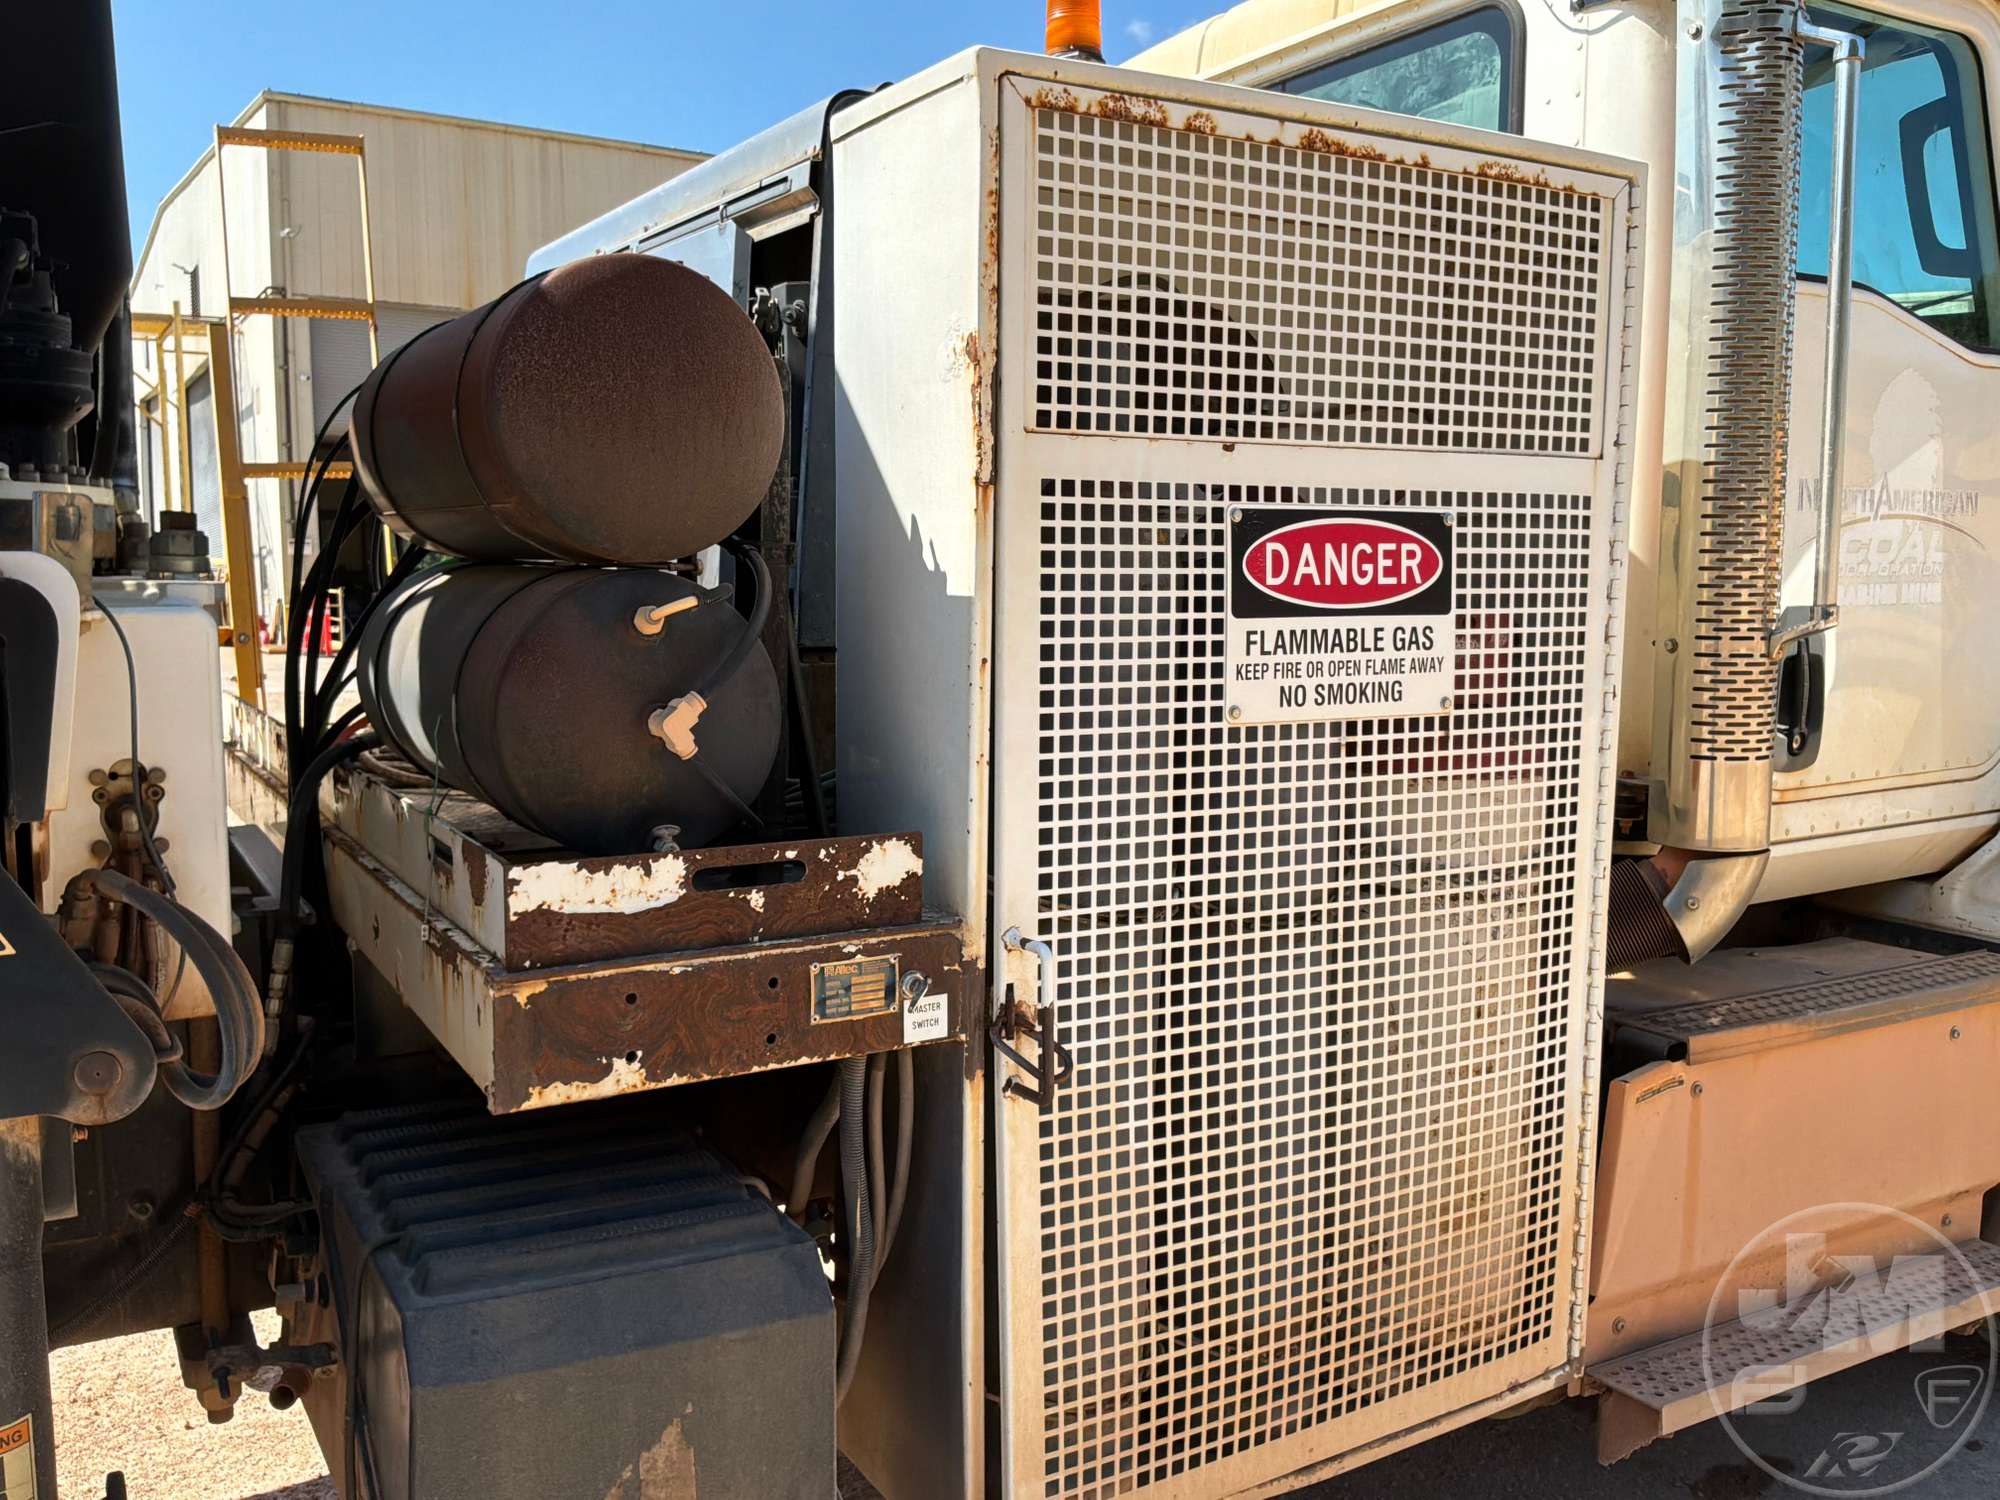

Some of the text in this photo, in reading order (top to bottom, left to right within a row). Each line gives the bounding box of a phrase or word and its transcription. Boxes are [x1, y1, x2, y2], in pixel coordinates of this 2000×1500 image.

[1265, 542, 1423, 586] DANGER
[1245, 627, 1385, 656] FLAMMABLE
[1392, 626, 1434, 652] GAS
[1236, 656, 1444, 681] KEEP FIRE OR OPEN FLAME AWAY
[1279, 680, 1403, 708] NO SMOKING
[912, 1001, 941, 1014] MASTER
[911, 1017, 940, 1030] SWITCH
